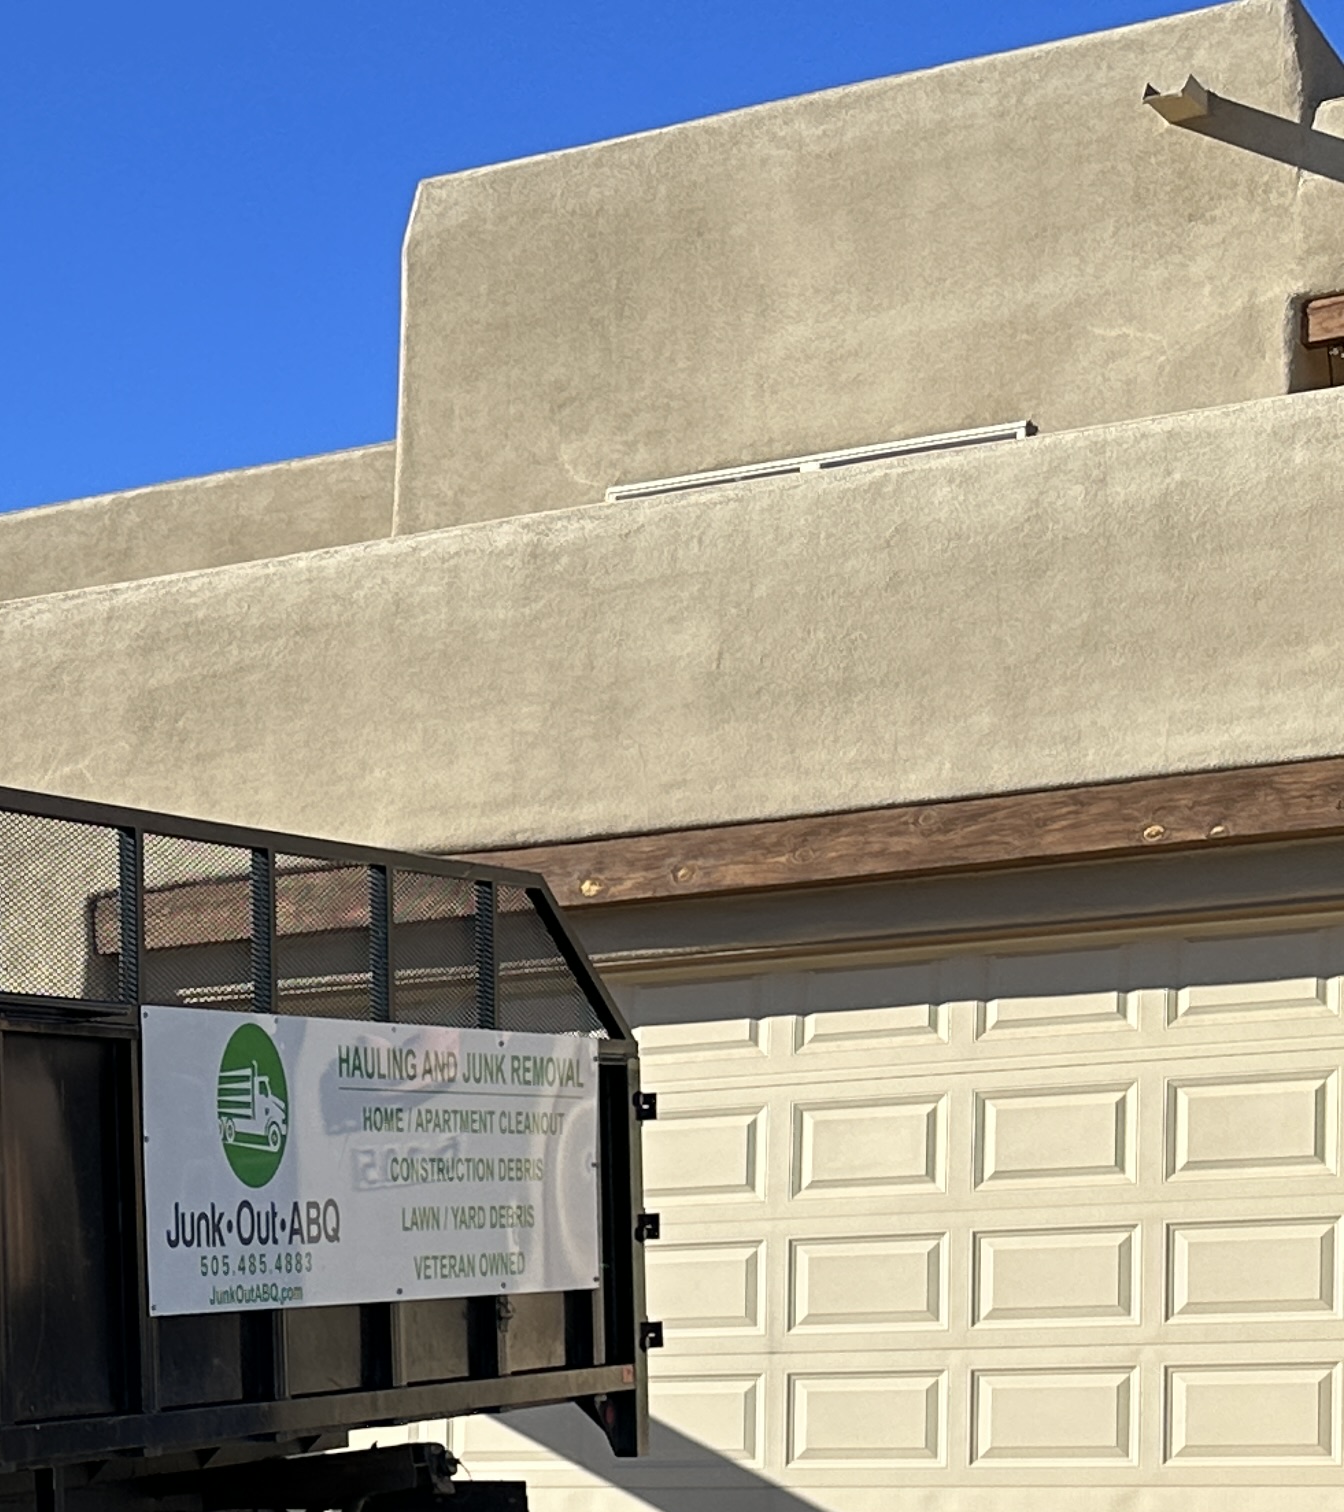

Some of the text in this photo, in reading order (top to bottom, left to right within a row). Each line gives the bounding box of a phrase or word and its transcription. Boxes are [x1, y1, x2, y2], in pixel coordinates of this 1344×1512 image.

[338, 1045, 585, 1088] HAULING AND JUNK REMOVAL
[363, 1106, 404, 1133] HOME
[415, 1108, 495, 1134] APARTMENT
[498, 1111, 566, 1135] CLEANOUT
[390, 1156, 496, 1183] CONSTRUCTION
[498, 1157, 544, 1182] DEBRIS
[401, 1206, 441, 1232] LAWN
[450, 1205, 487, 1230] YARD
[489, 1204, 535, 1230] DEBRIS
[200, 1252, 313, 1277] 505.485.4883
[413, 1252, 526, 1281] VETERAN OWNED
[209, 1282, 304, 1306] JunkOutABQ.com
